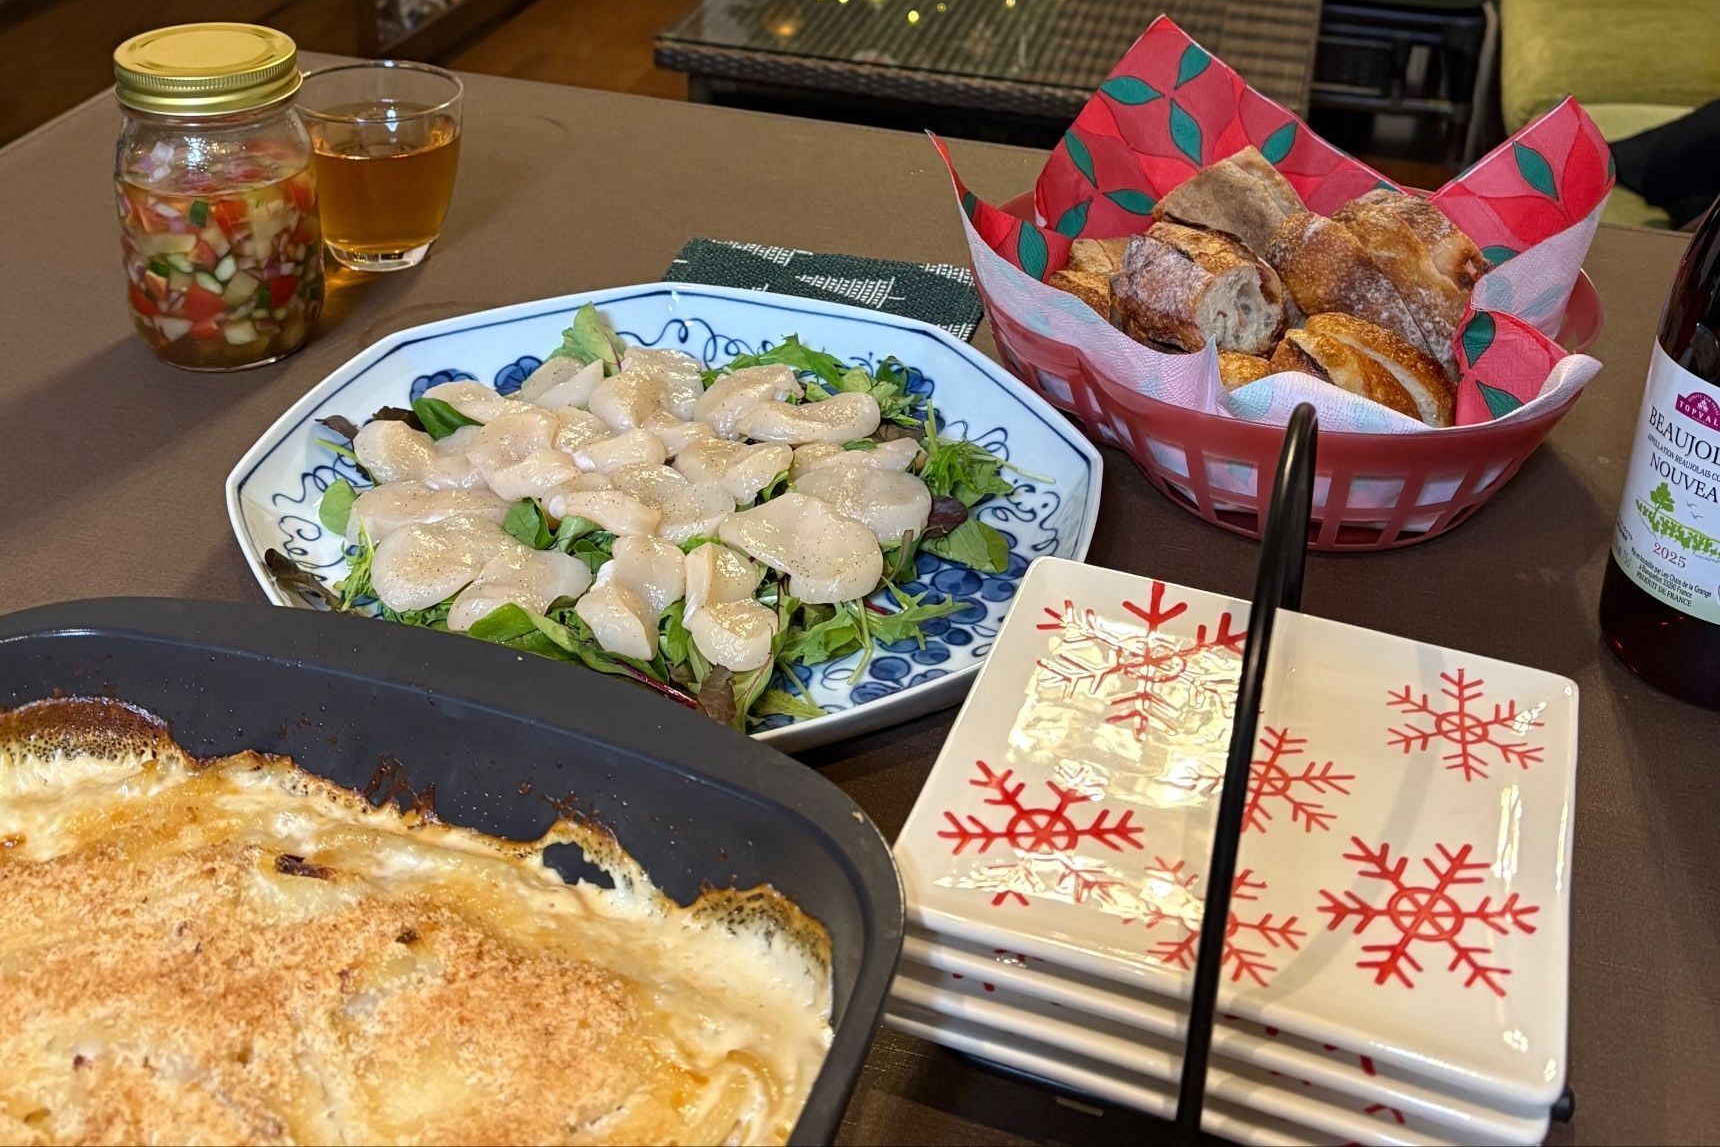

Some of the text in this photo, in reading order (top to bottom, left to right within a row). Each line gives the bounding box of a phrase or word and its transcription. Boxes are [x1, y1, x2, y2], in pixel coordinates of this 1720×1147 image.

[1649, 451, 1719, 504] NOUVEA
[1674, 454, 1711, 478] BEAUJOLAIS
[1652, 542, 1687, 569] 2025
[1636, 570, 1693, 608] PRODUIT DE FRANCE
[1676, 585, 1693, 599] France
[1694, 585, 1712, 599] Grange
